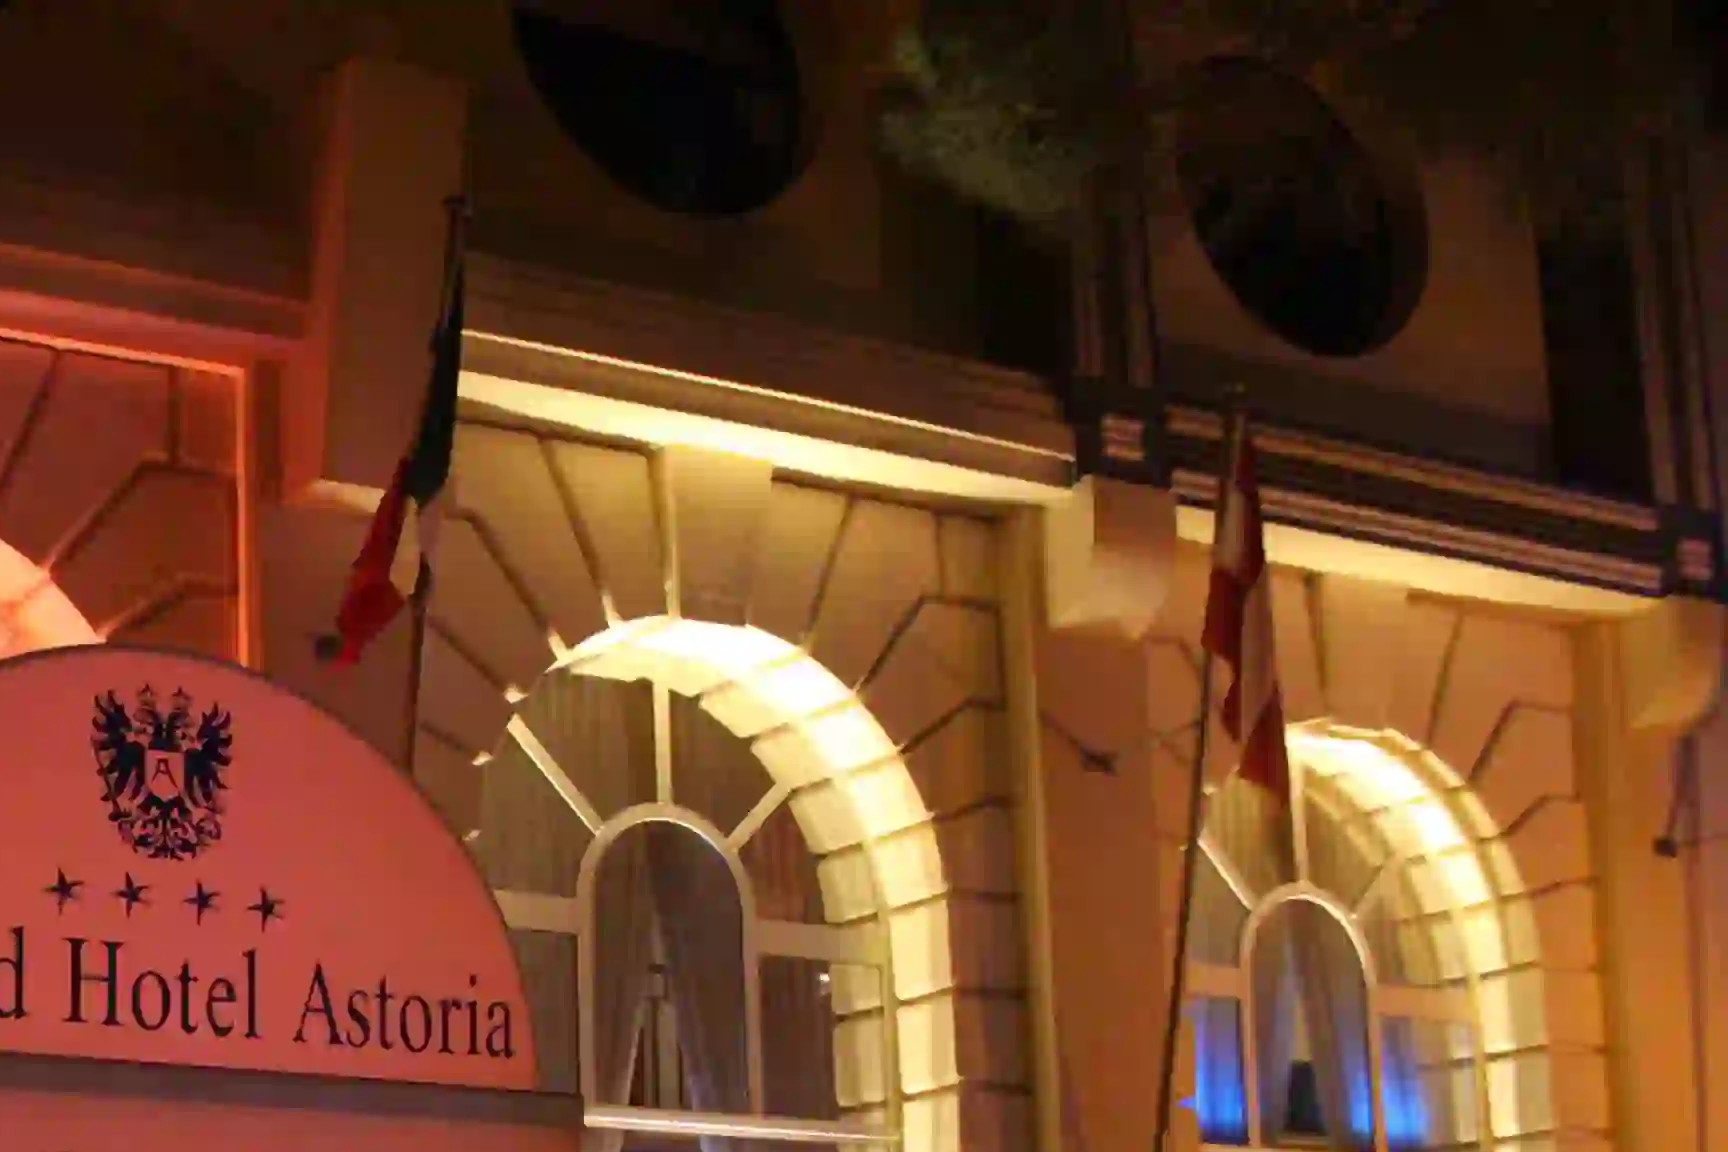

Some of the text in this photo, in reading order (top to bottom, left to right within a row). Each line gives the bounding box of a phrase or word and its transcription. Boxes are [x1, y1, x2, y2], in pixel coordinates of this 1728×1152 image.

[152, 758, 178, 787] A
[62, 937, 260, 1038] Hotel
[292, 962, 518, 1059] Astoria
